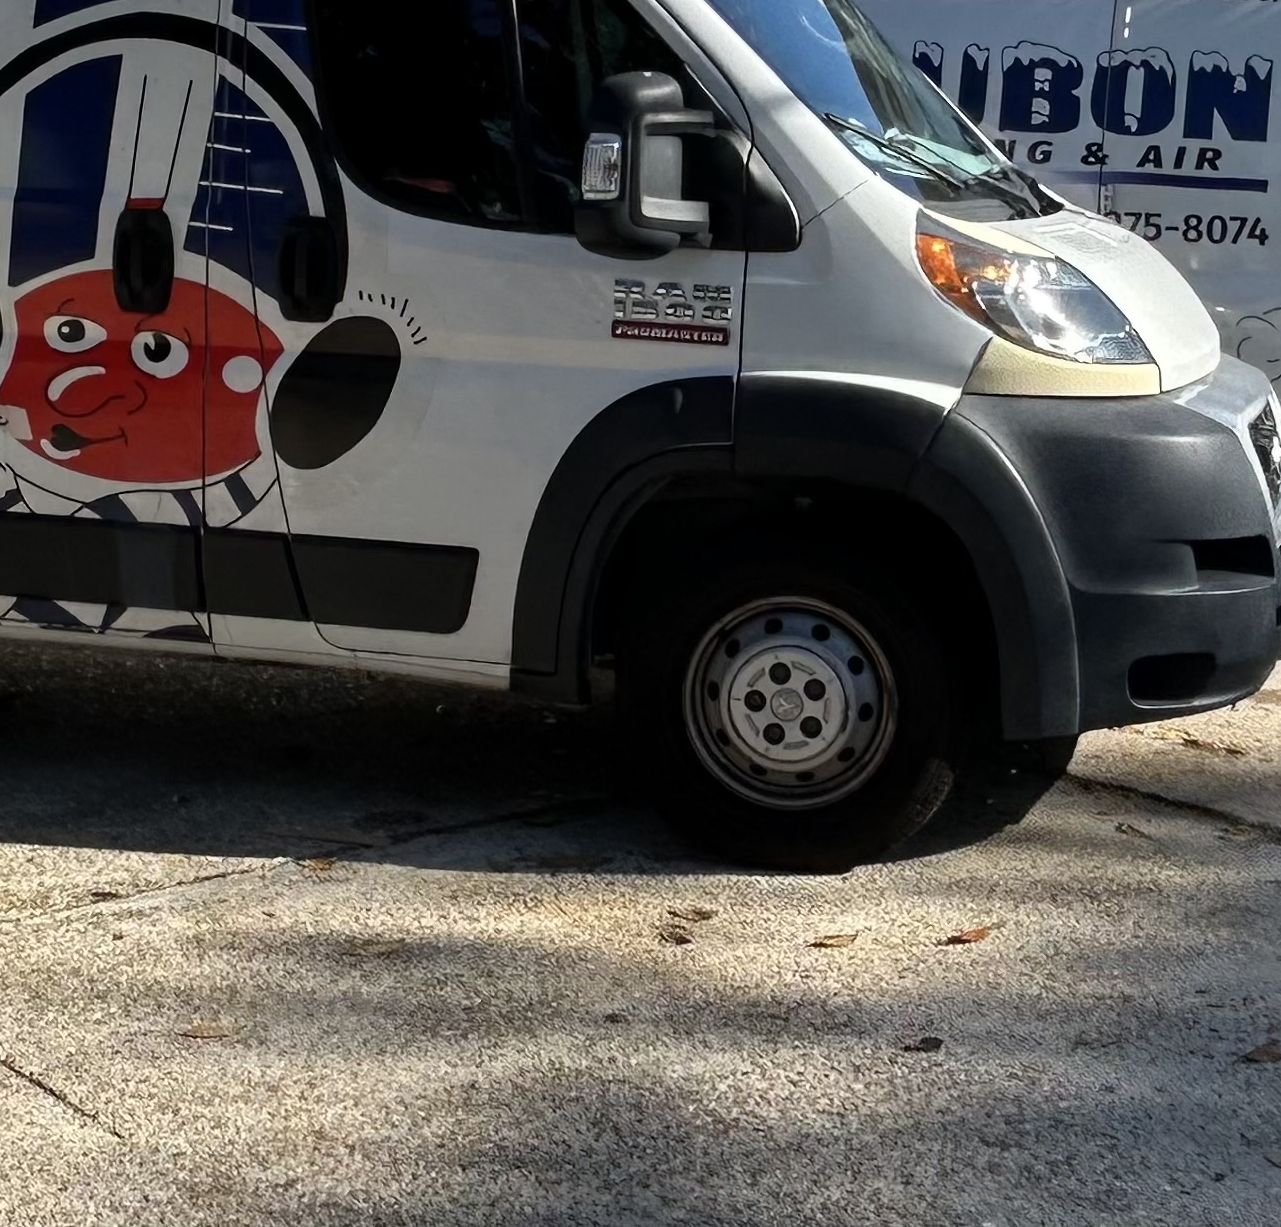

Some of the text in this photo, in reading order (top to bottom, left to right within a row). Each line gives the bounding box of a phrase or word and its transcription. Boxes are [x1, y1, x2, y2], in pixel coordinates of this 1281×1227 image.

[913, 39, 1274, 143] UBON
[1080, 142, 1108, 165] &
[1135, 144, 1223, 172] AIR
